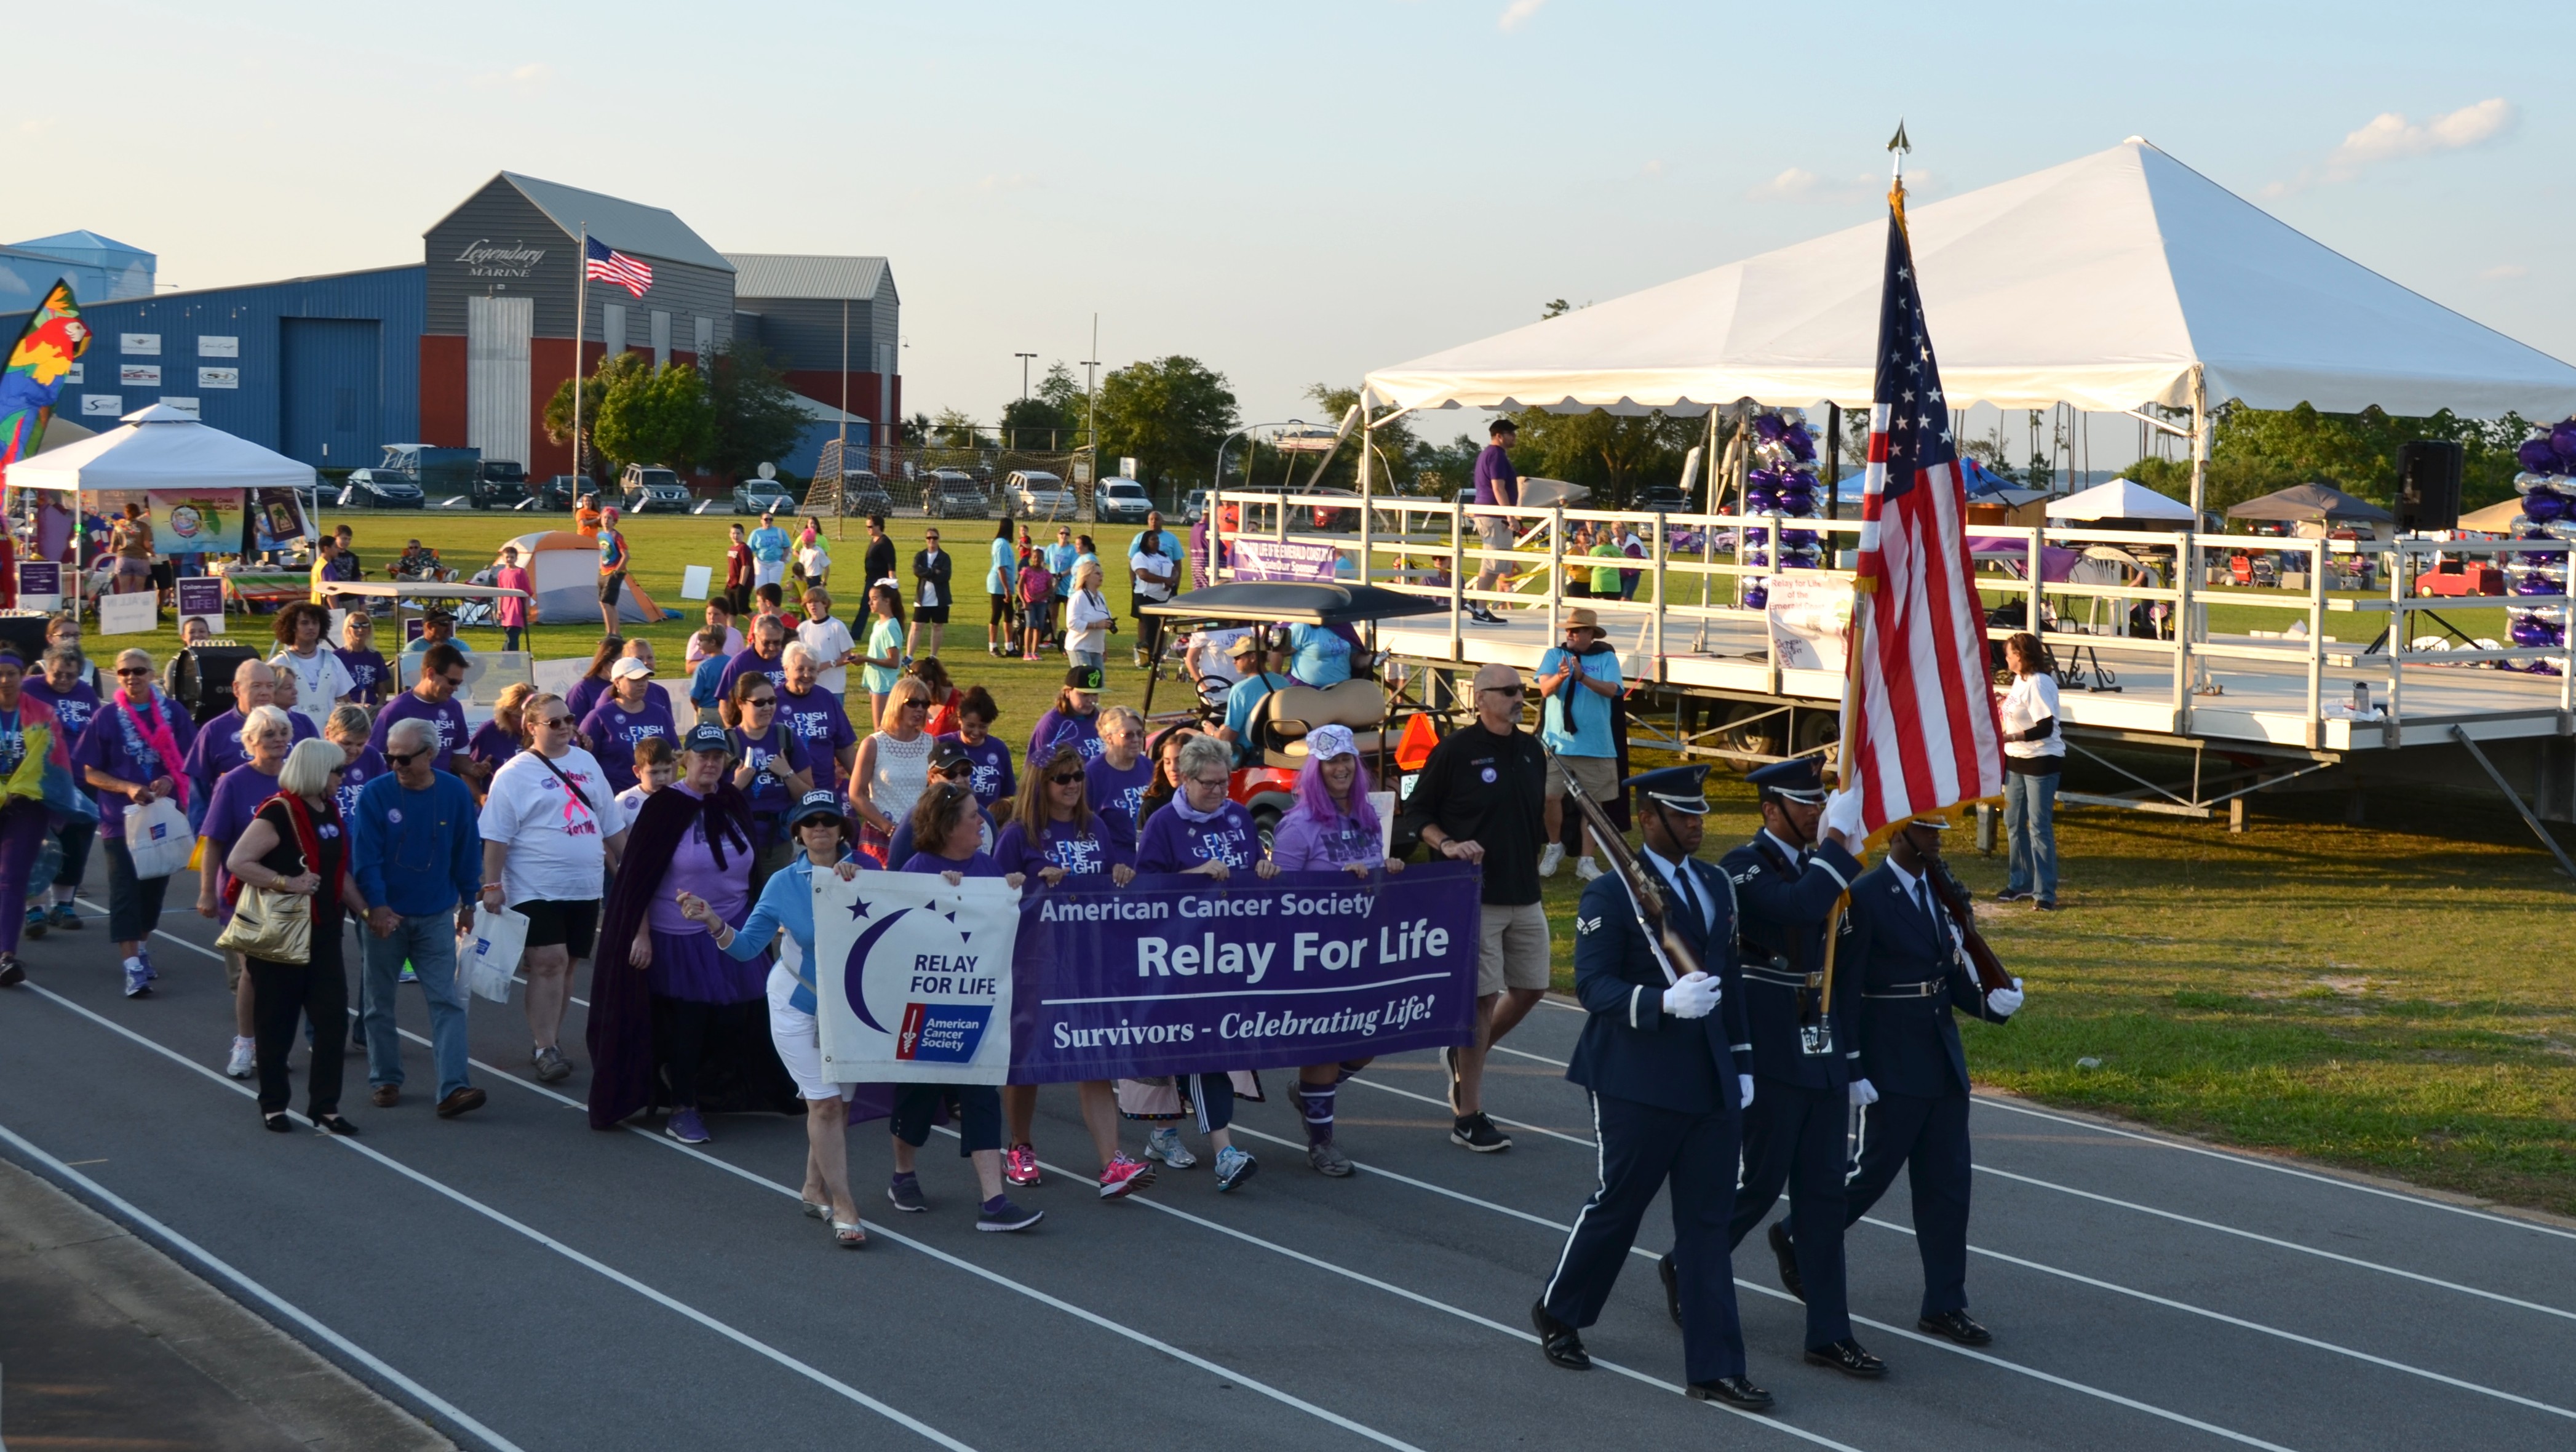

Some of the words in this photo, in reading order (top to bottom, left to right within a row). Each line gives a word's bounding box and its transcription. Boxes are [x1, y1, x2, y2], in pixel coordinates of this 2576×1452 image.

[455, 239, 546, 268] Legendary
[469, 268, 531, 277] MARINE
[185, 599, 217, 610] LIFE!
[1040, 896, 1169, 922] American
[1178, 895, 1272, 919] Cancer
[1280, 893, 1375, 919] Society
[1137, 932, 1276, 984] Relay
[1293, 931, 1368, 971] For
[1379, 918, 1449, 965] Life
[914, 954, 979, 973] RELAY
[910, 976, 952, 994] FOR
[958, 978, 996, 995] LIFE
[926, 1018, 979, 1029] American
[1053, 1019, 1195, 1049] Survivors
[1219, 1007, 1380, 1040] Celebrating
[1382, 994, 1436, 1030] Life!
[924, 1028, 964, 1040] Cancer
[921, 1037, 964, 1051] Society
